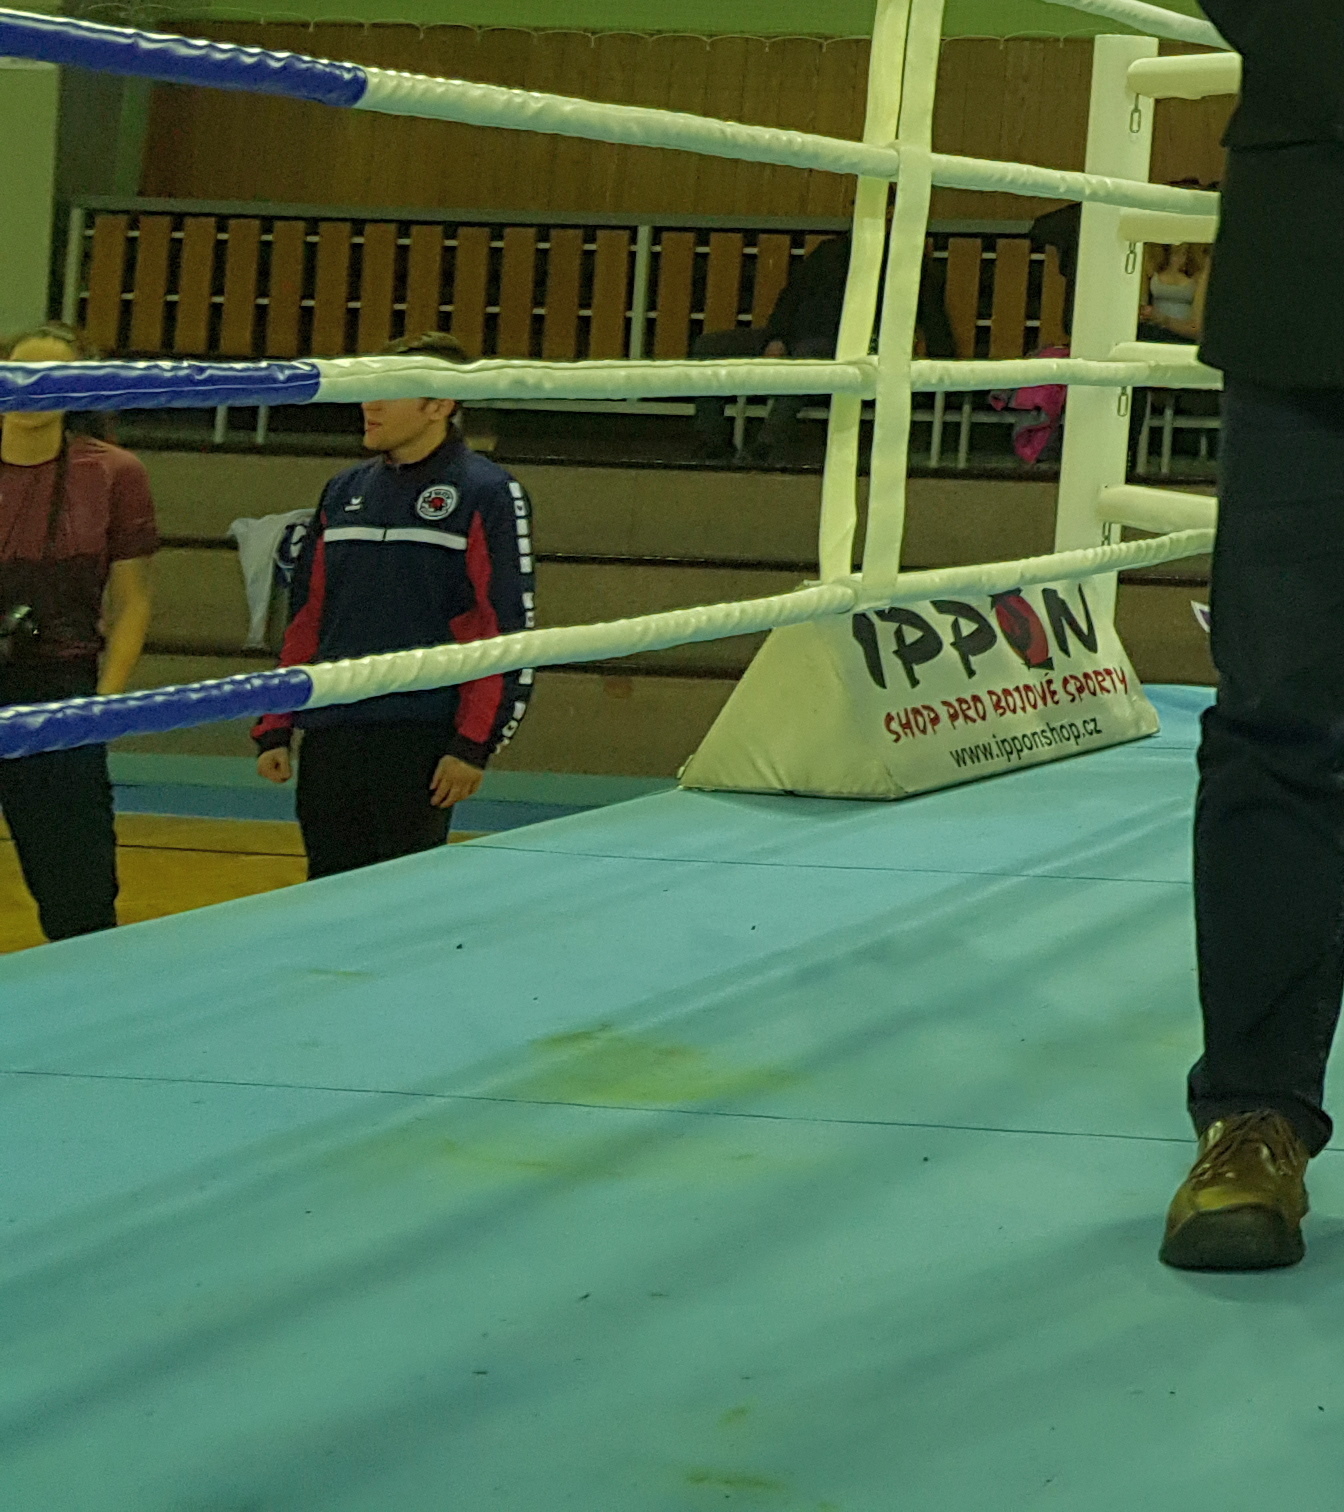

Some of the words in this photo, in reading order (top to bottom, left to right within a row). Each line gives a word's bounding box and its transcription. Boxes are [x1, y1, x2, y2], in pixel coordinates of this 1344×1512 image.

[852, 583, 1100, 690] IPPON
[884, 704, 942, 744] SHOP
[941, 694, 987, 730] PRO
[986, 672, 1060, 718] BOJOVÉ
[1061, 666, 1129, 704] SPORTY
[949, 717, 1103, 769] www.ipponshop.cz
